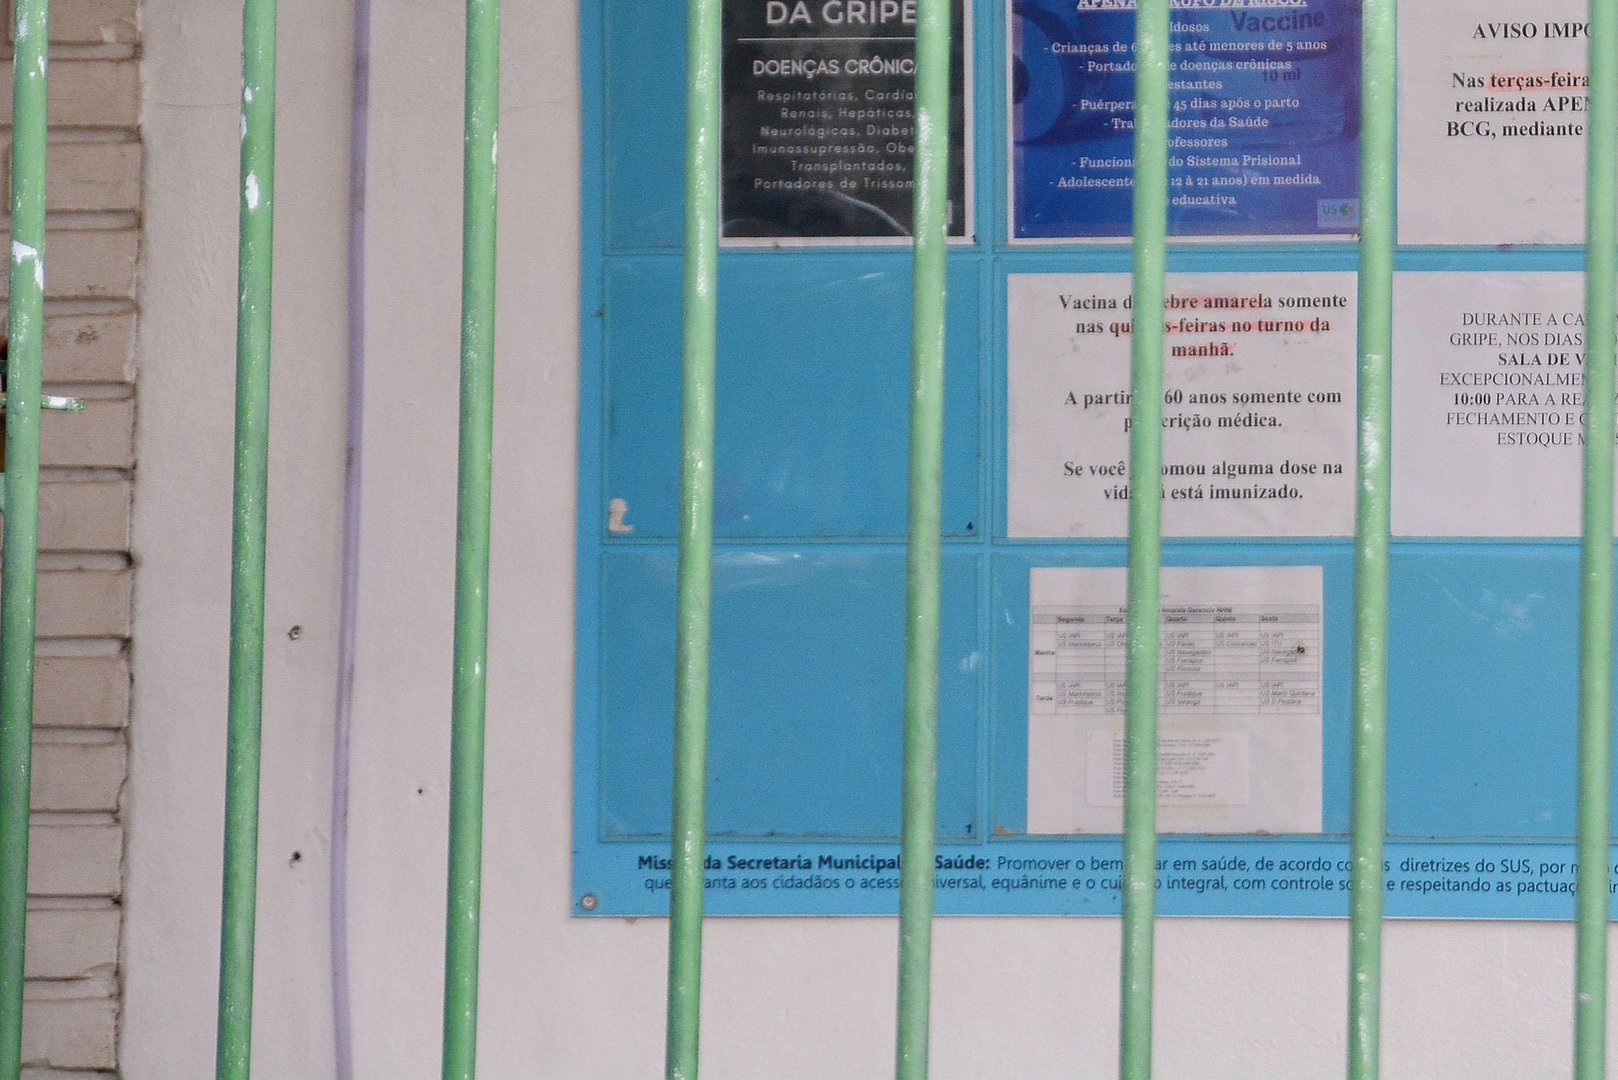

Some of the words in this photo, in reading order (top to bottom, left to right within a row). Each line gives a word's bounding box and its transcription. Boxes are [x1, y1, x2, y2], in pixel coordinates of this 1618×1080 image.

[766, 0, 811, 25] DA
[822, 0, 918, 25] GRIPE
[1472, 22, 1538, 39] AVISO
[1051, 41, 1110, 54] Crianças
[1112, 41, 1128, 53] de
[1185, 40, 1206, 52] até
[1209, 41, 1265, 51] menores
[1267, 39, 1283, 51] de
[1286, 42, 1293, 53] 5
[1296, 40, 1328, 50] anos
[753, 59, 840, 79] DOENÇAS
[844, 55, 918, 75] CRÔNIC
[1181, 60, 1233, 73] doenças
[1235, 58, 1293, 71] crônicas
[1452, 73, 1485, 89] Nas
[1173, 100, 1188, 111] 45
[1190, 97, 1218, 109] dias
[1220, 97, 1251, 110] após
[1253, 99, 1262, 108] o
[1264, 97, 1300, 110] parto
[1455, 95, 1537, 113] realizada
[1209, 116, 1227, 128] da
[1228, 115, 1269, 128] Saúde
[1446, 120, 1496, 139] BCG,
[1502, 120, 1584, 137] mediante
[1169, 156, 1184, 167] do
[1186, 155, 1240, 167] Sistema
[1242, 154, 1302, 167] Prisional
[753, 178, 834, 190] Portadores
[839, 178, 858, 189] de
[1211, 173, 1248, 187] anos)
[1250, 176, 1270, 186] em
[1273, 173, 1321, 186] medida
[1172, 193, 1238, 206] educativa
[1059, 294, 1125, 310] Vacina
[1203, 293, 1273, 309] amarela
[1277, 293, 1348, 308] somente
[1076, 322, 1104, 334] nas
[1231, 321, 1252, 333] no
[1257, 319, 1304, 333] turno
[1310, 317, 1331, 333] da
[1462, 312, 1543, 327] DURANTE
[1546, 312, 1559, 326] A
[1449, 332, 1503, 348] GRIPE,
[1506, 332, 1540, 346] NOS
[1543, 332, 1584, 346] DIAS
[1171, 342, 1235, 357] manhã.
[1498, 352, 1543, 367] SALA
[1547, 352, 1570, 367] DE
[1064, 391, 1078, 406] A
[1083, 390, 1133, 410] partir
[1164, 390, 1183, 404] 60
[1189, 392, 1227, 405] anos
[1232, 389, 1303, 405] somente
[1306, 392, 1342, 404] com
[1453, 392, 1492, 407] 10:00
[1495, 392, 1540, 407] PARA
[1543, 392, 1557, 406] A
[1217, 412, 1283, 428] médica.
[1446, 411, 1561, 427] FECHAMENTO
[1564, 412, 1576, 426] E
[1497, 432, 1574, 449] ESTOQUE
[1063, 461, 1084, 476] Se
[1089, 461, 1126, 476] você
[1211, 460, 1275, 481] alguma
[1279, 460, 1319, 475] dose
[1322, 463, 1344, 475] na
[1171, 484, 1204, 500] está
[1209, 484, 1304, 500] imunizado.
[703, 855, 722, 871] da
[727, 855, 813, 871] Secretaria
[817, 854, 901, 874] Municipal
[935, 854, 990, 871] Saúde:
[997, 856, 1071, 871] Promover
[1075, 860, 1086, 871] o
[1172, 860, 1197, 871] em
[1201, 856, 1250, 873] saúde,
[1255, 856, 1275, 871] de
[1279, 857, 1333, 872] acordo
[1399, 858, 1471, 873] diretrizes
[1475, 858, 1496, 873] do
[1500, 858, 1534, 875] SUS,
[1539, 862, 1568, 878] por
[644, 878, 672, 893] que
[741, 879, 768, 890] aos
[772, 874, 841, 890] cidadãos
[844, 878, 855, 890] o
[991, 875, 1068, 893] equânime
[1071, 878, 1081, 890] e
[1085, 878, 1096, 890] o
[1167, 875, 1228, 894] integral,
[1232, 878, 1266, 890] com
[1270, 876, 1334, 891] controle
[1386, 880, 1396, 891] e
[1400, 877, 1491, 895] respeitando
[1495, 882, 1512, 893] as
